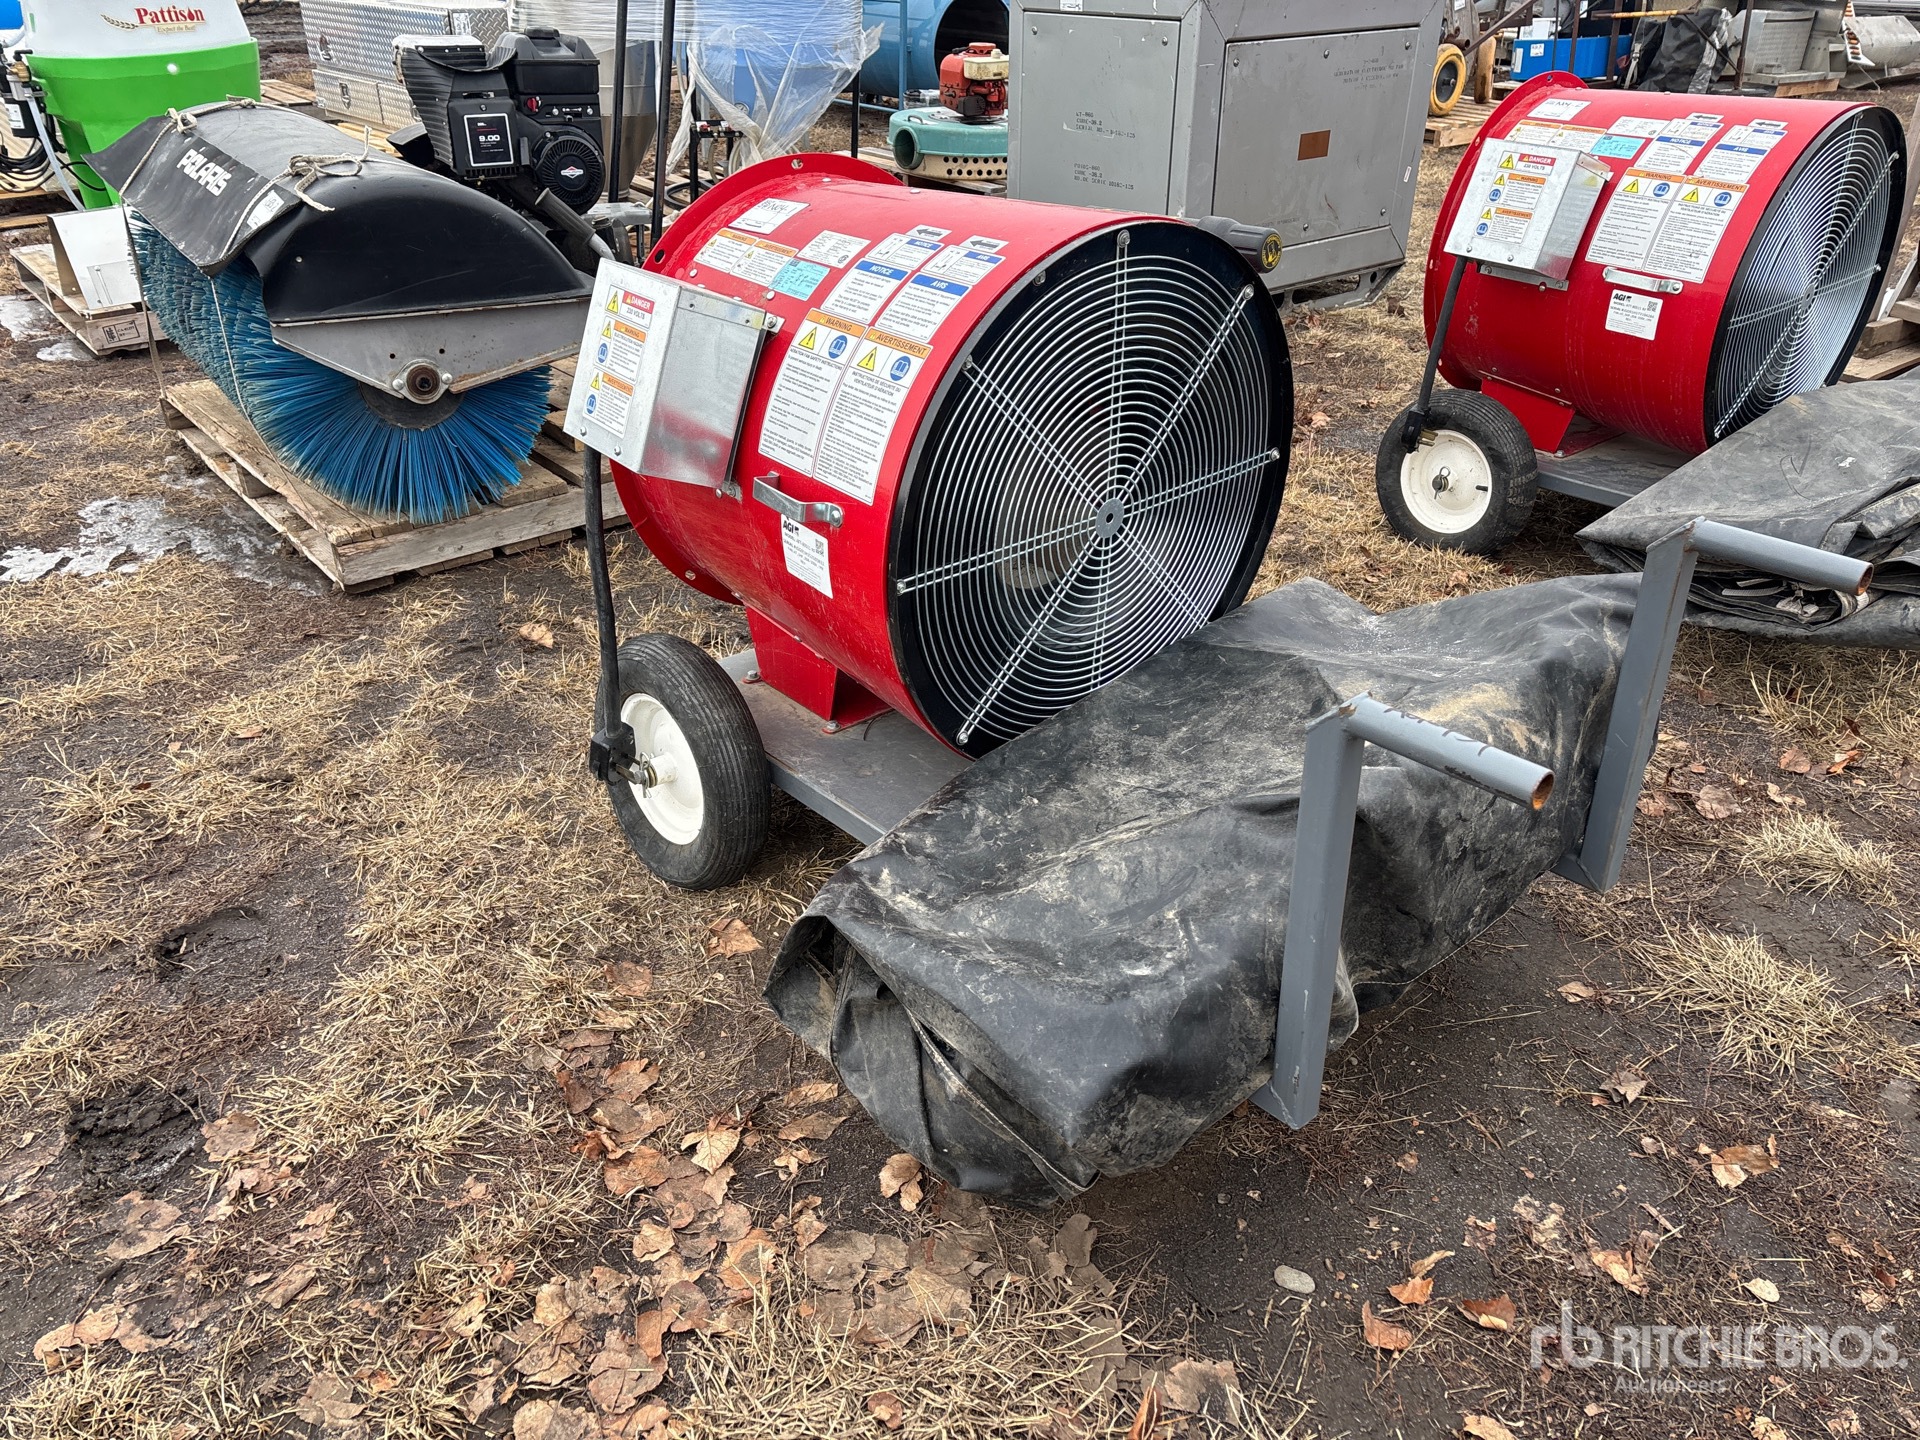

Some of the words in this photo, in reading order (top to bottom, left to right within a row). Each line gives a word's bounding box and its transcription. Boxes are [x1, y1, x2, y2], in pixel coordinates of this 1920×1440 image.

[135, 5, 205, 24] Pattison
[479, 134, 500, 142] 9.00
[1529, 155, 1552, 164] DANGER
[176, 148, 232, 196] POLARIS
[1645, 172, 1672, 180] WARNING
[1696, 179, 1744, 191] AVERTISSEMENT
[914, 240, 933, 248] NOTICE
[869, 264, 893, 275] NOTICE
[930, 280, 950, 289] AVIS
[1613, 293, 1626, 301] AGI
[631, 296, 651, 310] DANGER
[633, 309, 645, 320] VOLTS
[825, 317, 853, 332] WARNING
[624, 327, 640, 337] WARNING
[876, 334, 927, 356] AVERTISSEMENT
[852, 370, 874, 382] INSTRUCTIONS
[783, 520, 794, 534] AGI
